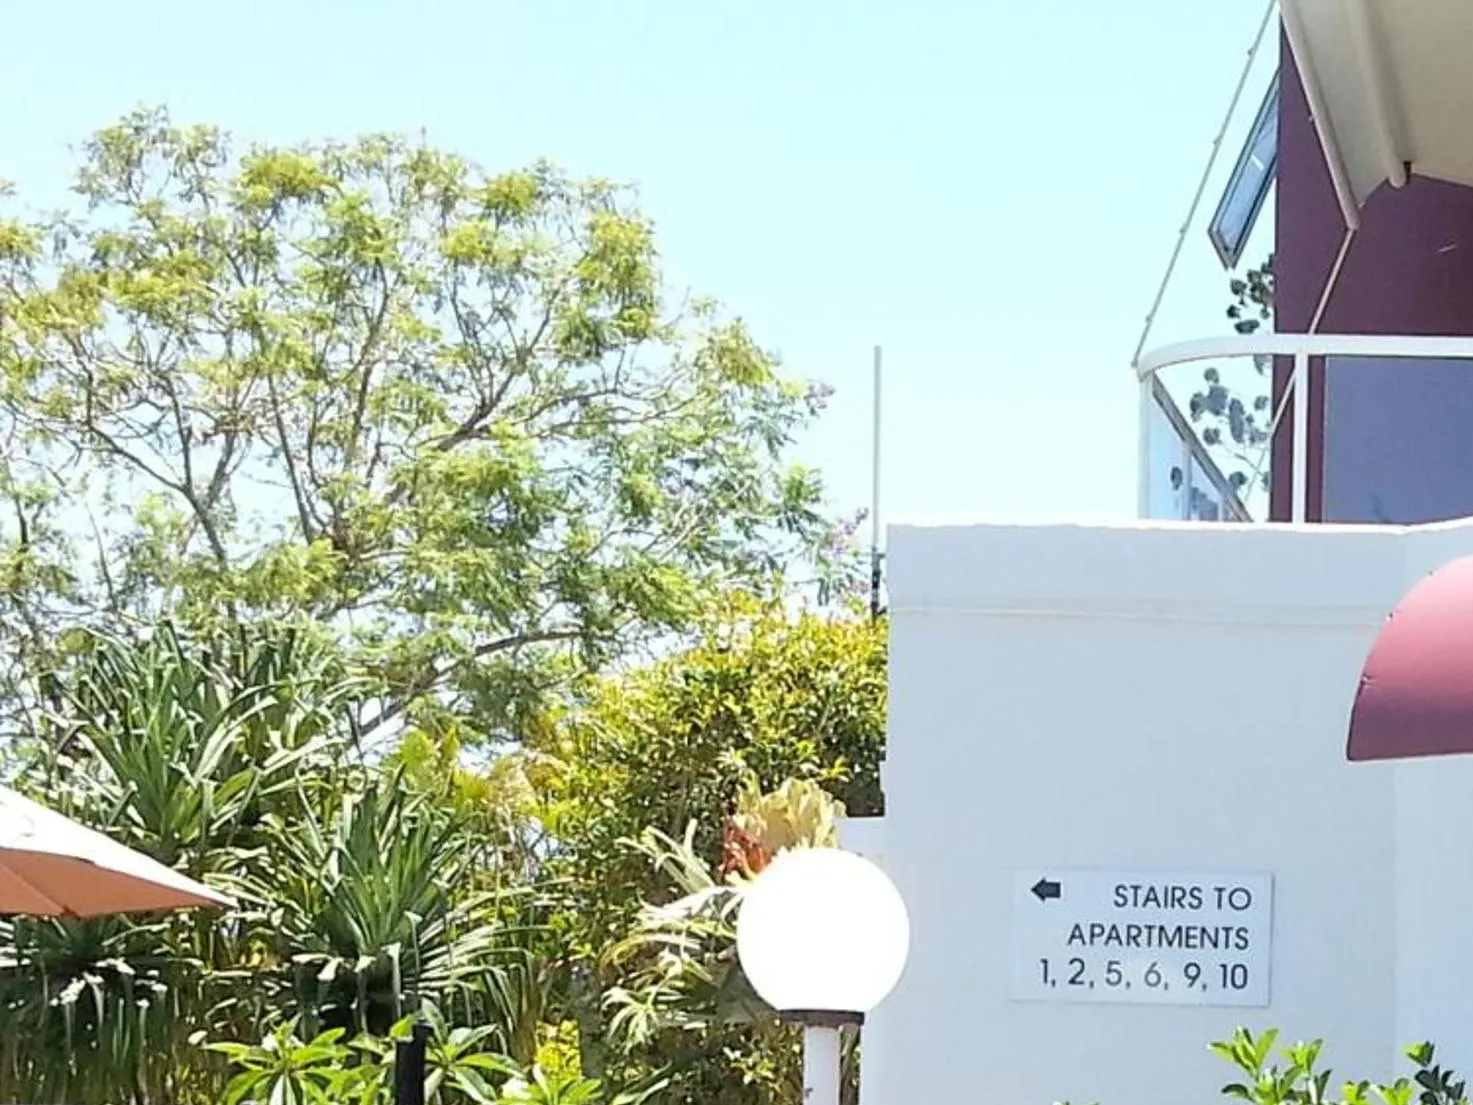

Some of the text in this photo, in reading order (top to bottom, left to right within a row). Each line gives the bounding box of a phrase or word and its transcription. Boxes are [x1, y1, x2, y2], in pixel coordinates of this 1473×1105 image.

[1112, 884, 1252, 911] STAIRS TO
[1067, 922, 1249, 951] APARTMENTS
[1219, 963, 1249, 990] 10
